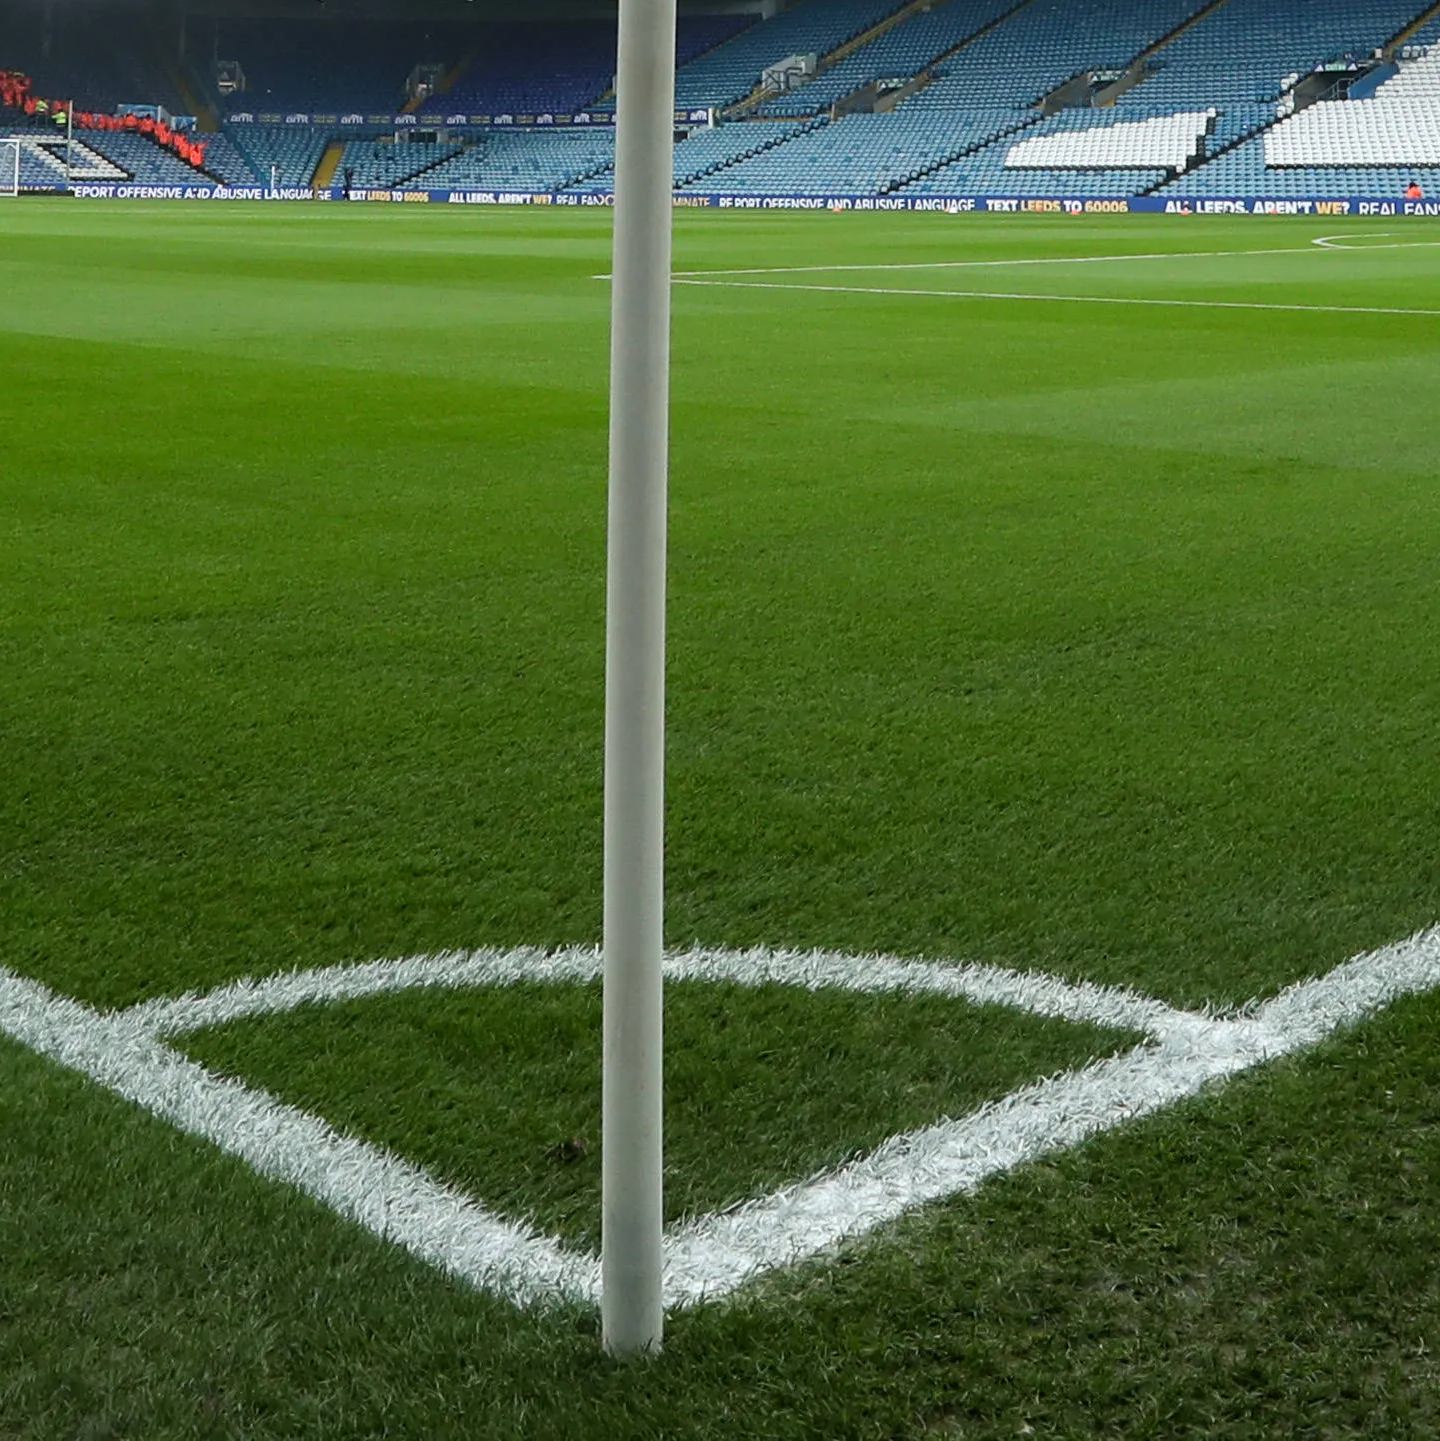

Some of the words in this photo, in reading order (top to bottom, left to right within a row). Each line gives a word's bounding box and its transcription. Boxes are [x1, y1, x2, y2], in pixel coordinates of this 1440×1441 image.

[117, 186, 183, 199] OFFENSIVE
[212, 188, 261, 200] ABUSIVE
[367, 190, 391, 202] LEEDS
[392, 191, 402, 202] TO
[986, 199, 1018, 212] TEXT
[1021, 200, 1060, 213] LEEDS
[1063, 200, 1082, 213] TO
[1084, 200, 1129, 213] 60006
[1315, 201, 1350, 215] WE?
